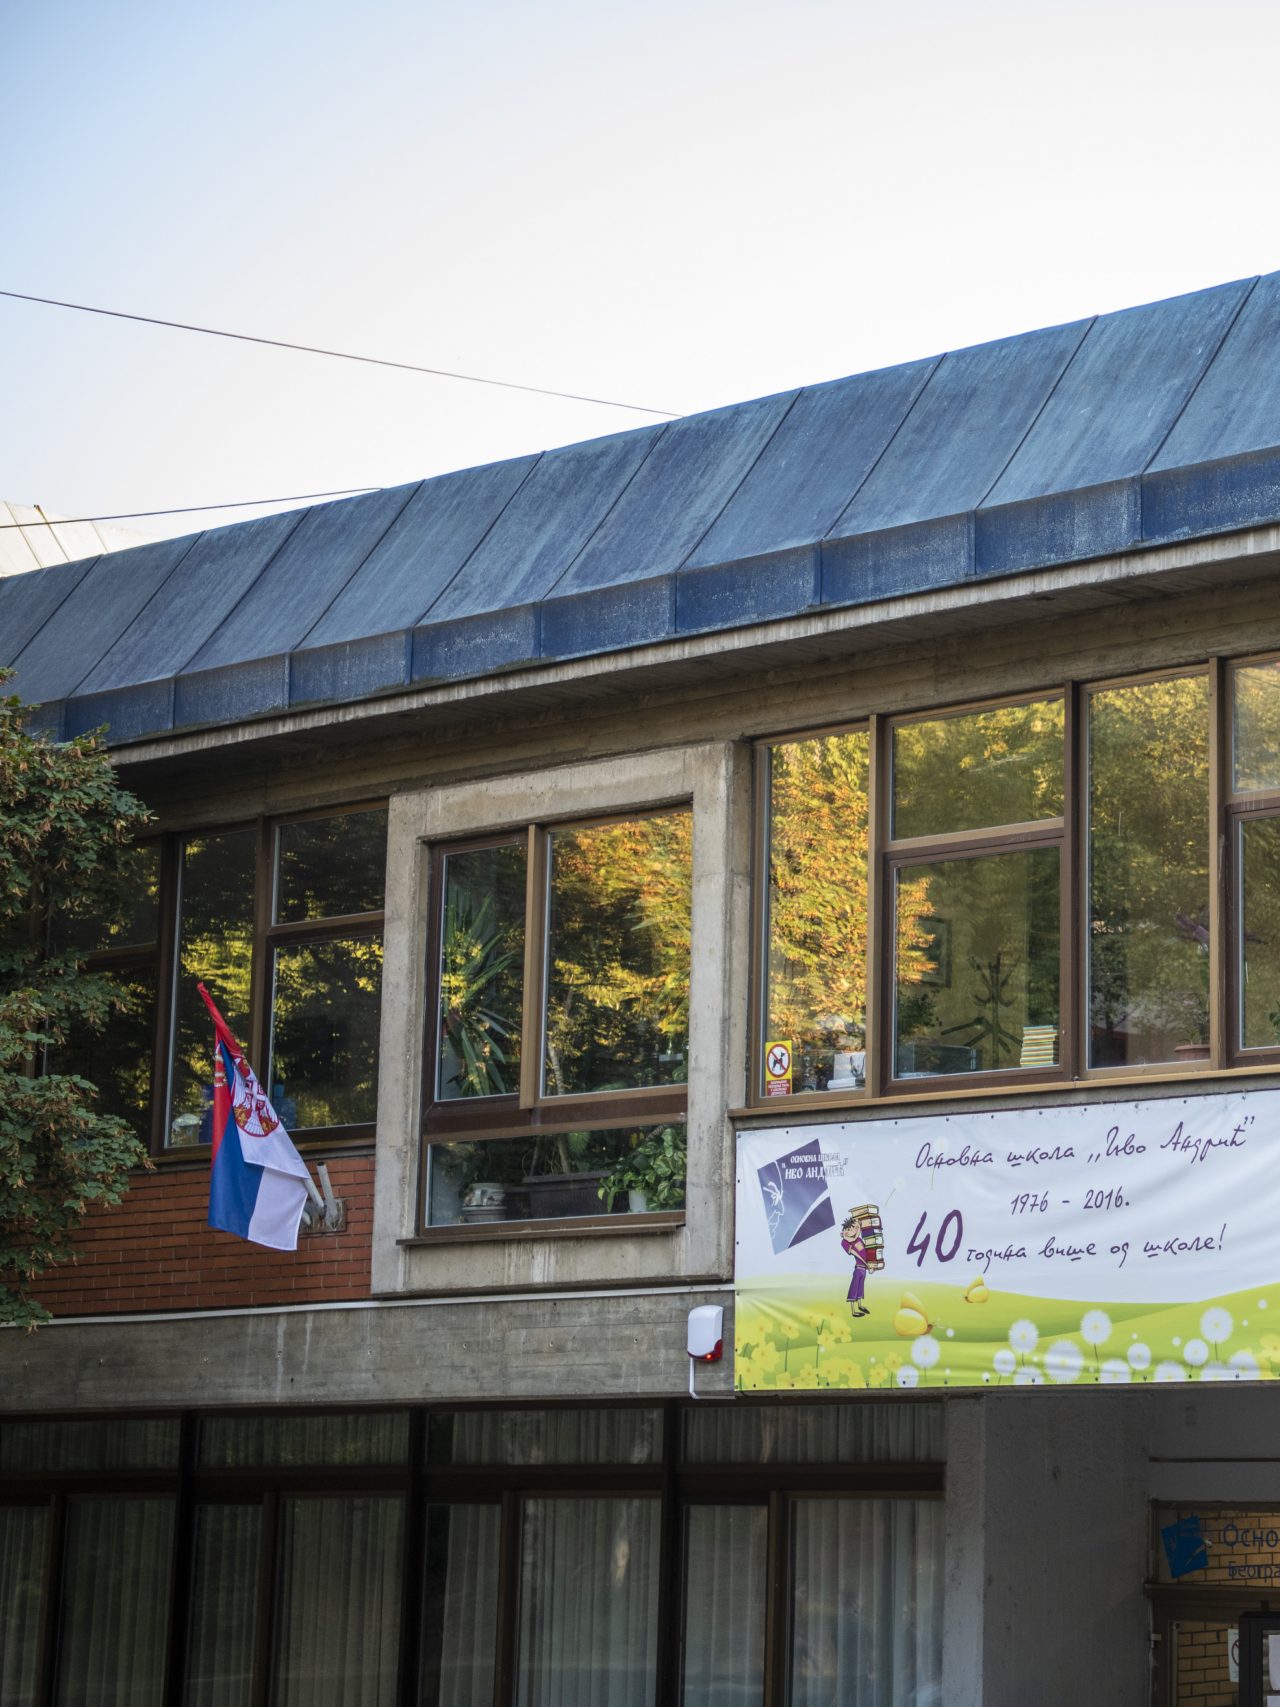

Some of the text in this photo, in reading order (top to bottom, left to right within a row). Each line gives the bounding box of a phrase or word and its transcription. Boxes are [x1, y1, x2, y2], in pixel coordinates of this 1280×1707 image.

[914, 1142, 994, 1169] Основна
[1007, 1144, 1075, 1167] школа
[1010, 1191, 1049, 1215] 1976
[1083, 1186, 1130, 1211] 2016.
[905, 1209, 1228, 1274] 40 година више од школе!
